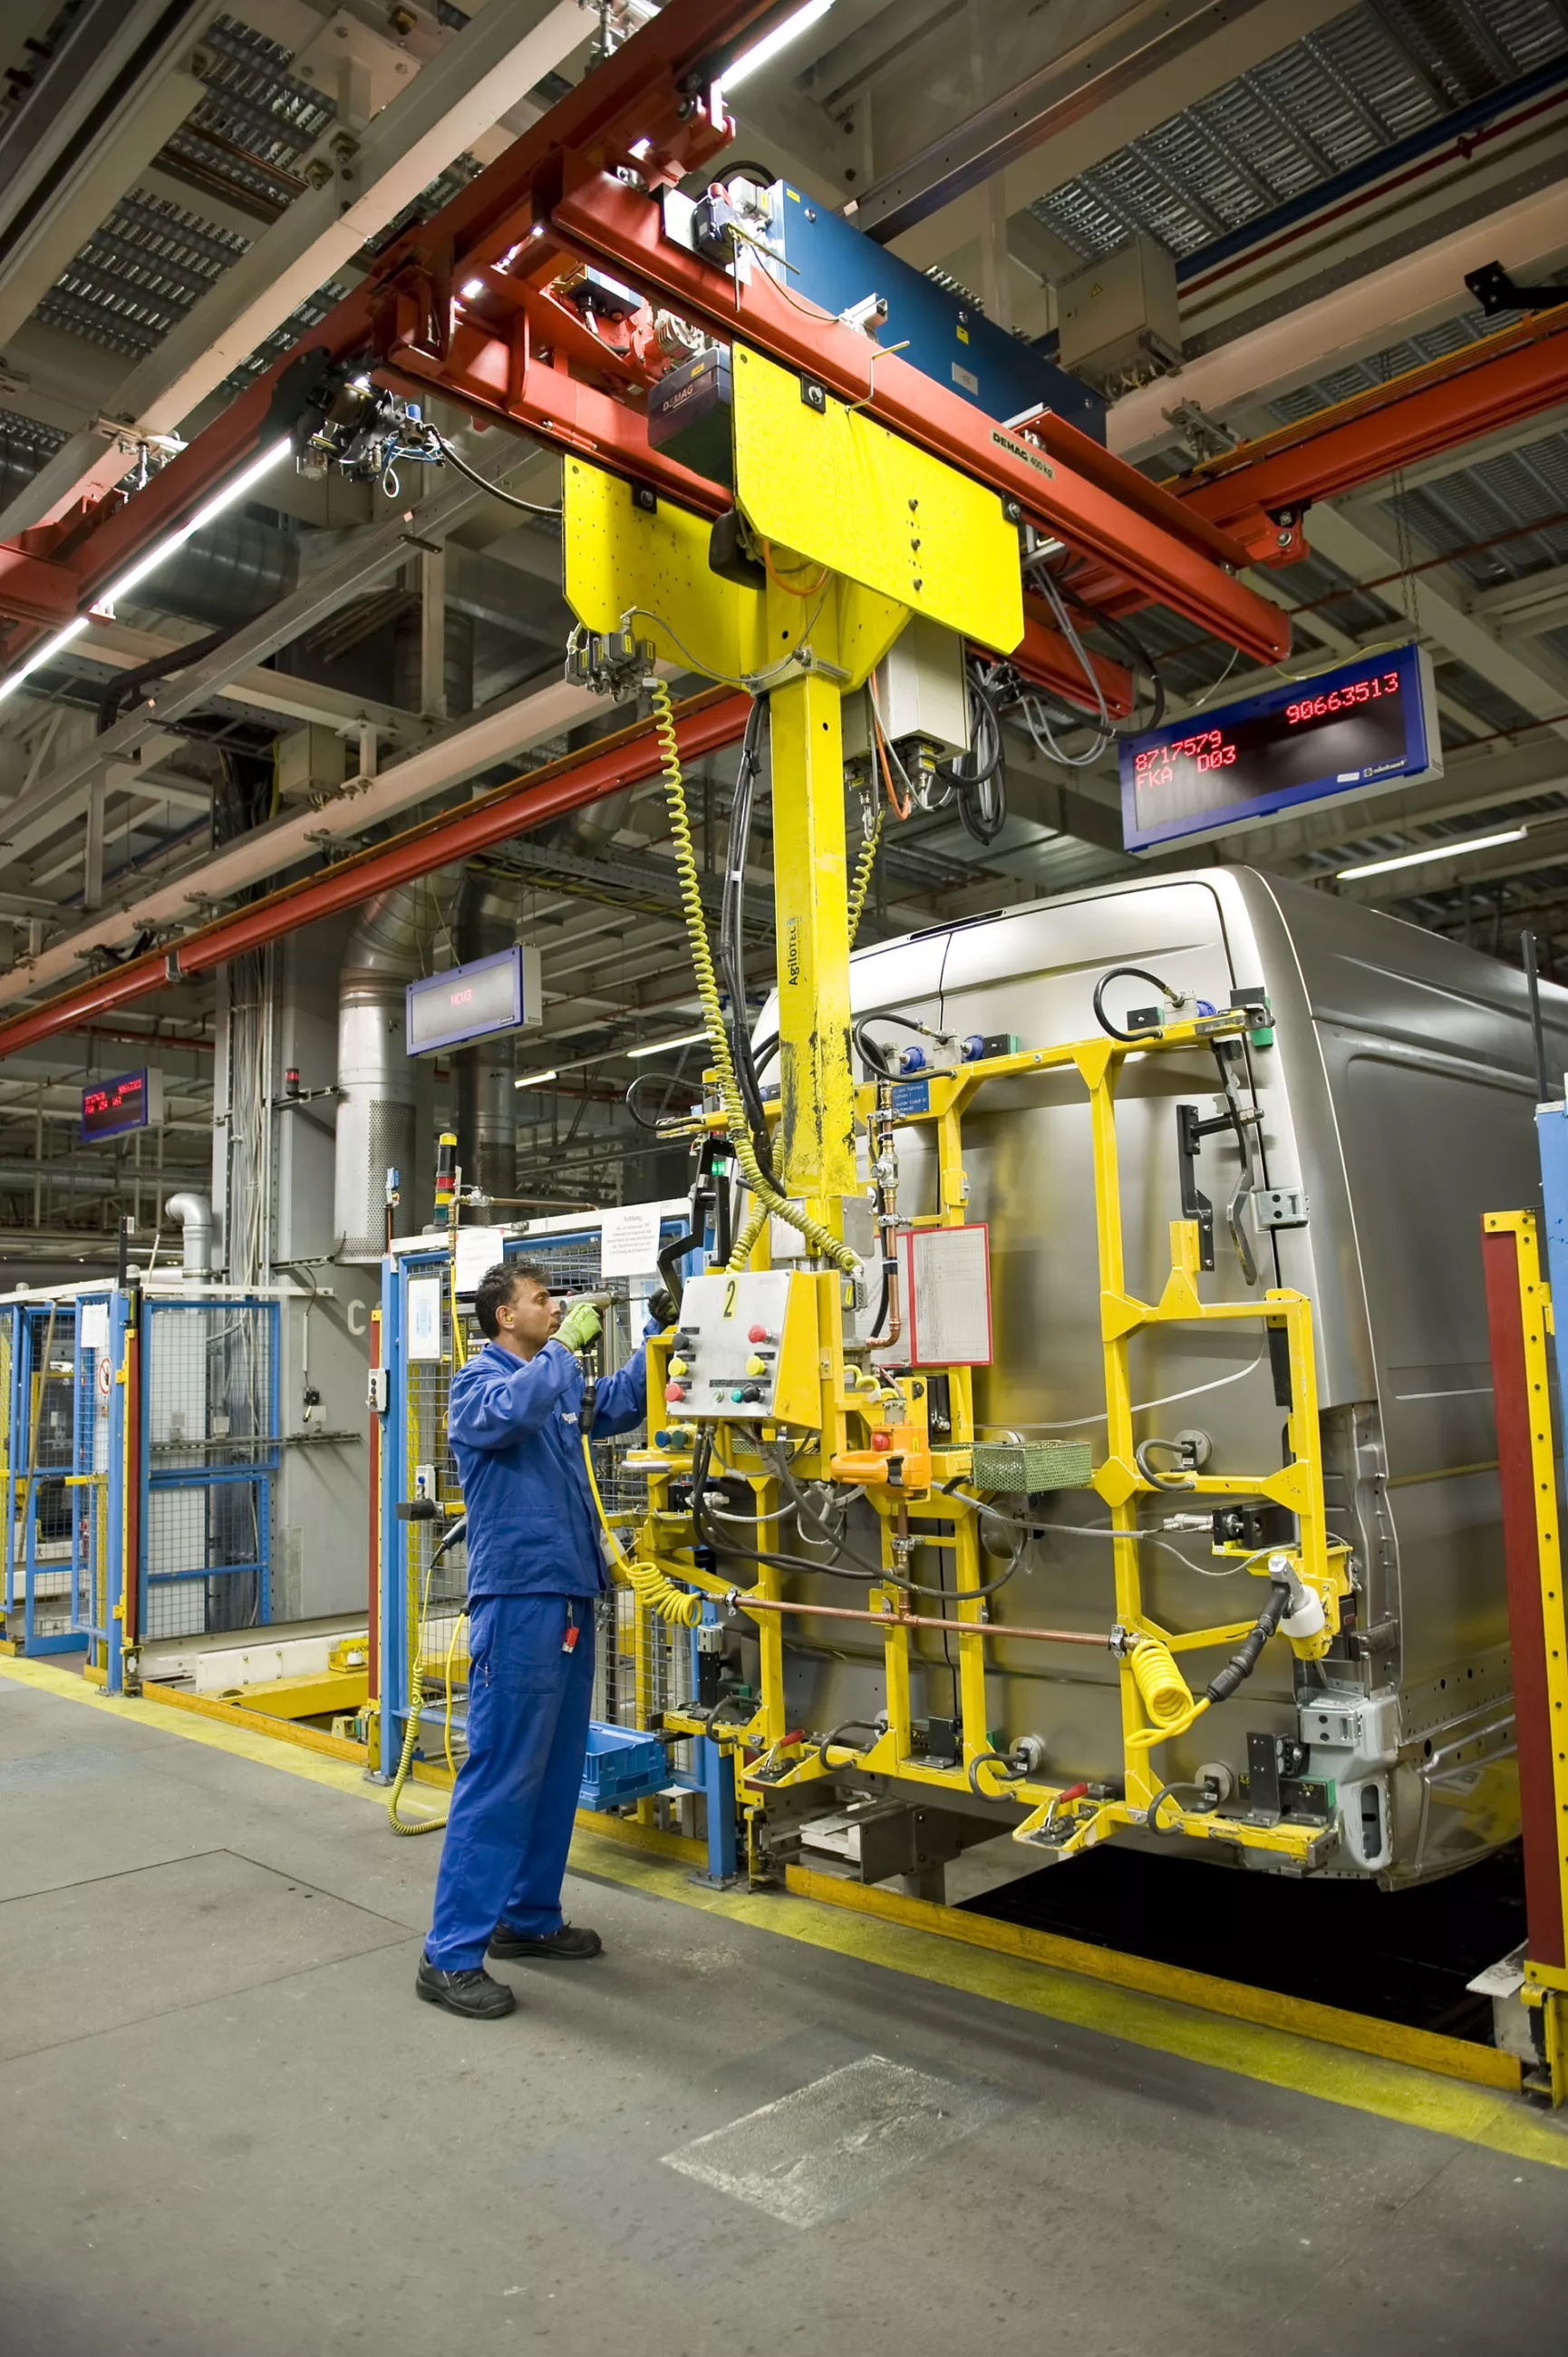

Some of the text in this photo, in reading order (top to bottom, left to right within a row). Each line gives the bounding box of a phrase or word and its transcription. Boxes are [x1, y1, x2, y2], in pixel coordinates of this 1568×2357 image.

[663, 384, 693, 412] DEMAG
[993, 432, 1028, 461] DEMAG
[1285, 672, 1399, 724] 90663513
[1136, 730, 1222, 771] 8717579
[1136, 744, 1236, 791] FKA D03
[723, 1280, 736, 1317] 2
